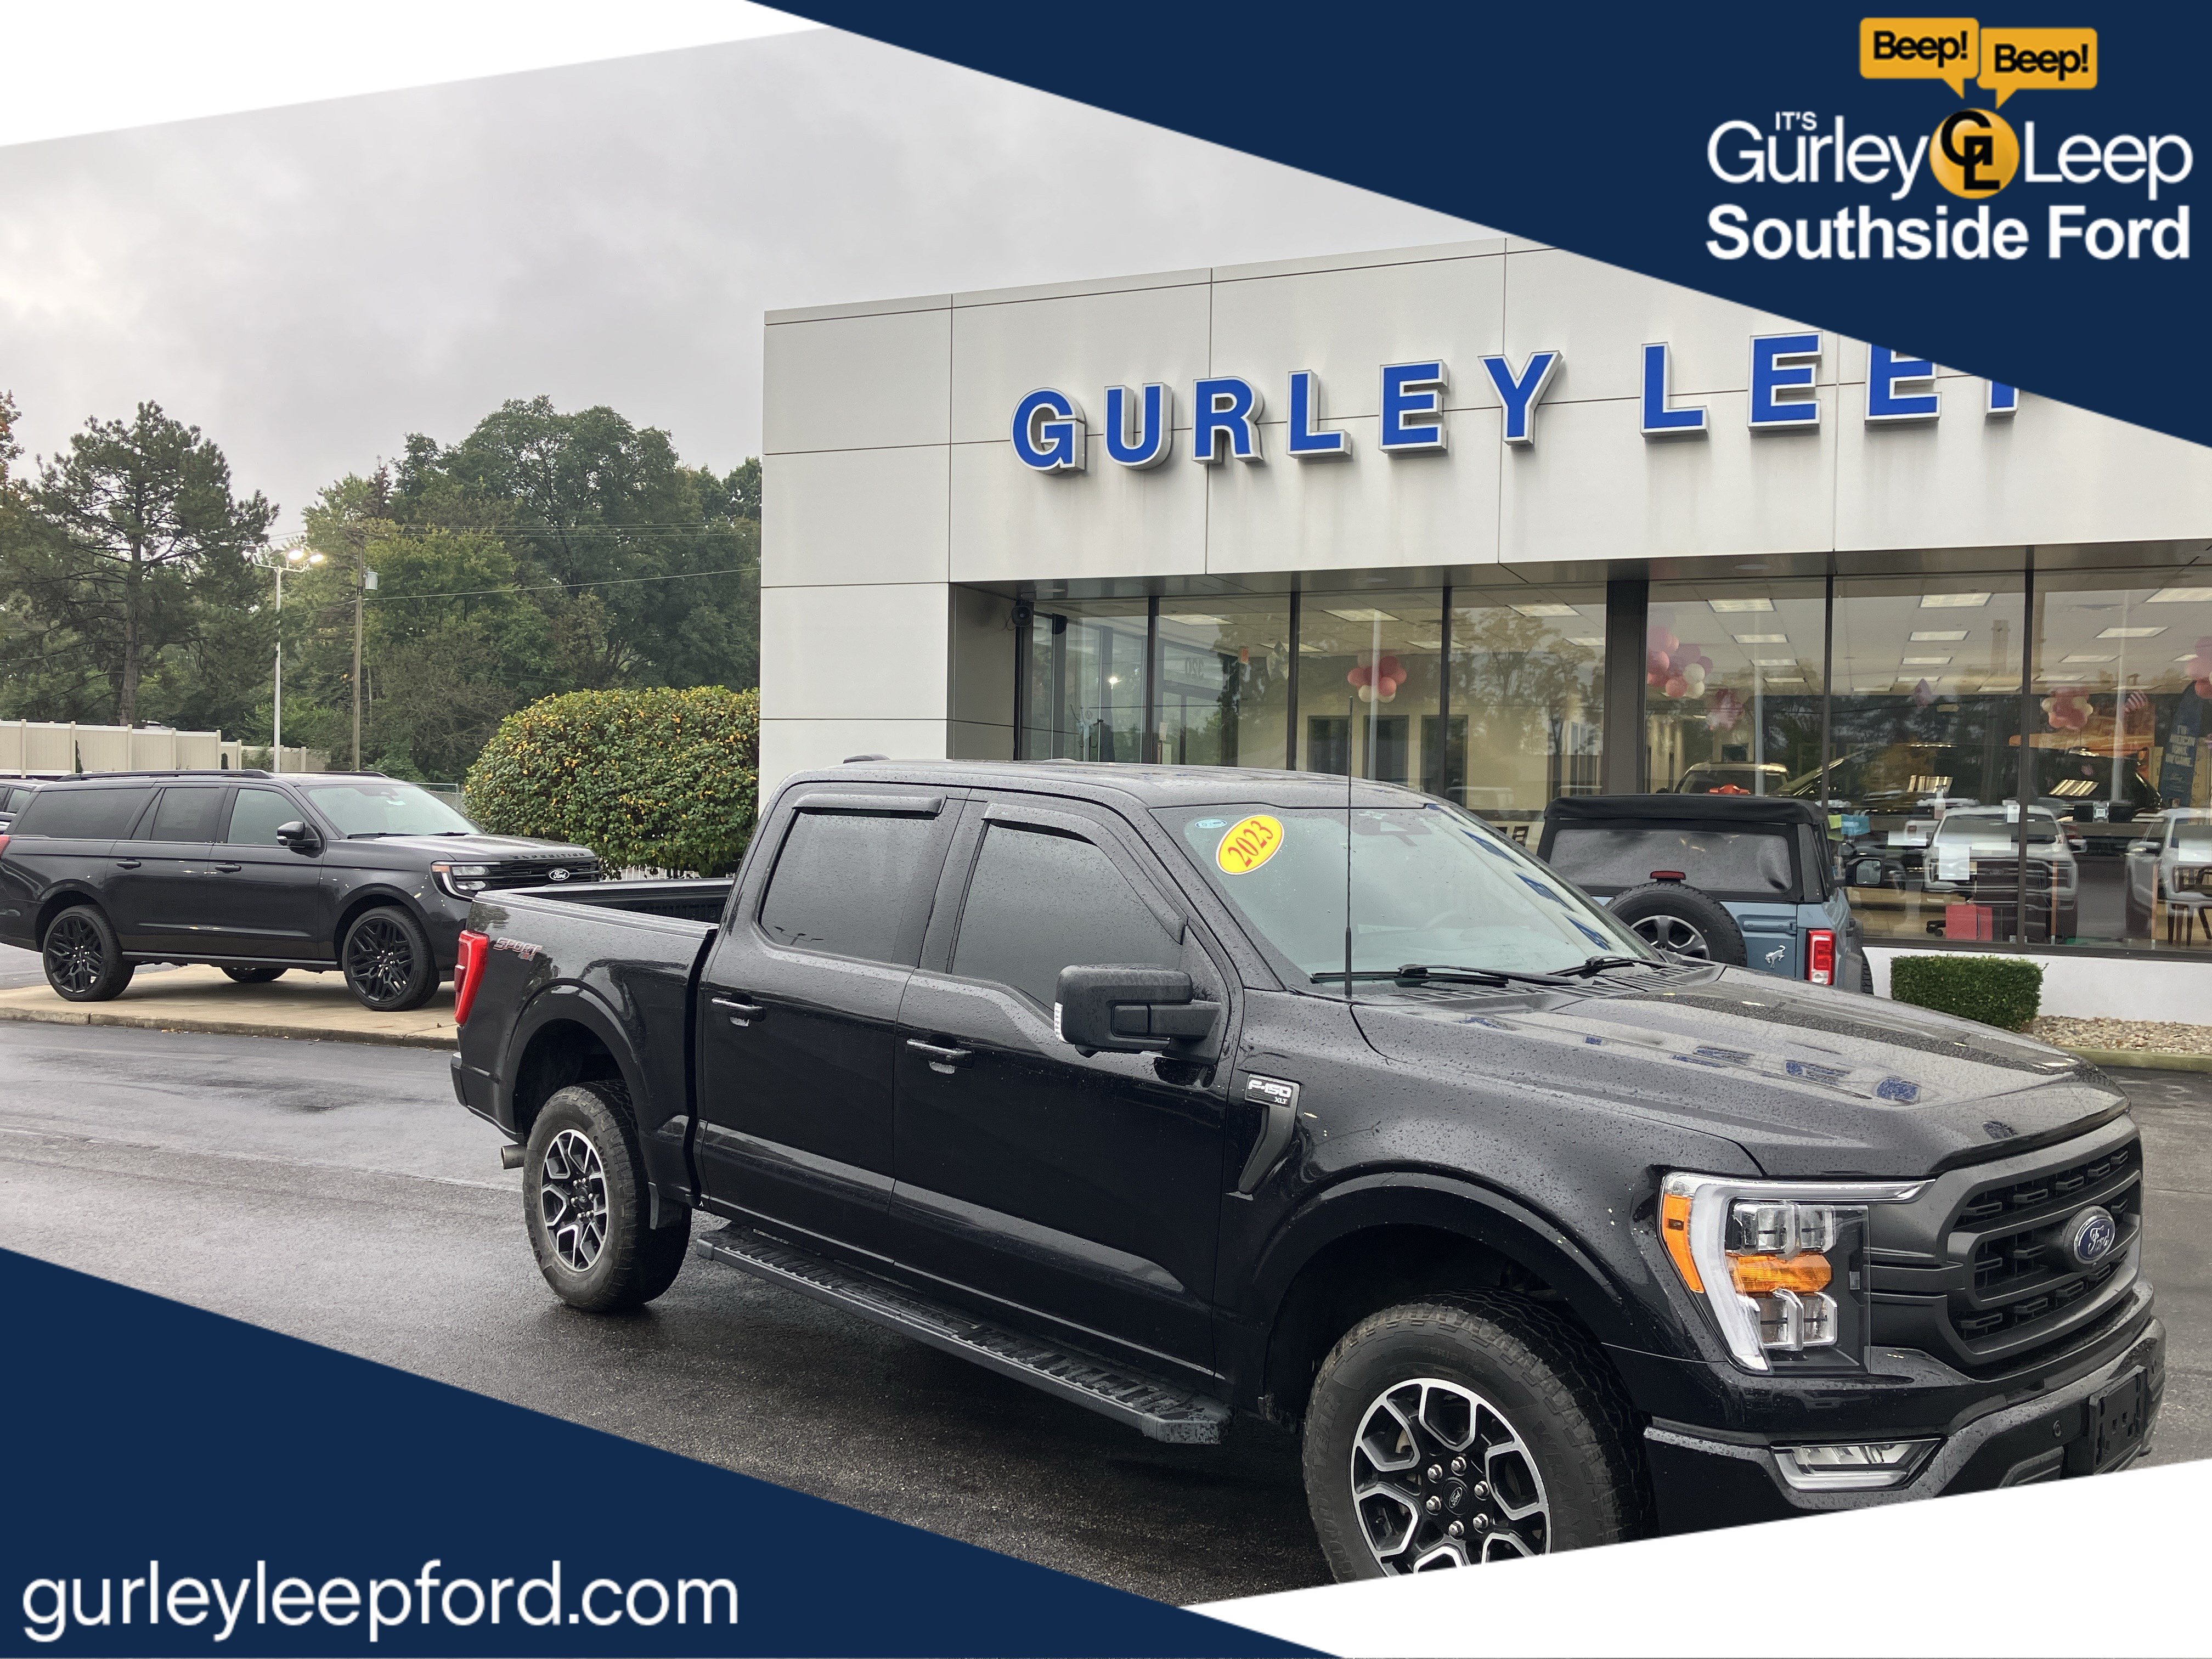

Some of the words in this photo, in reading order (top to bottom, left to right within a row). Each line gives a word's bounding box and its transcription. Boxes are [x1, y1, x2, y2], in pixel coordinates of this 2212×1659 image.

[1011, 352, 1559, 471] GURLEY
[1641, 330, 2018, 432] LEE
[1228, 820, 1273, 867] 2023
[552, 871, 567, 879] Ford
[493, 936, 543, 956] SPORT
[1248, 1079, 1292, 1098] F-150
